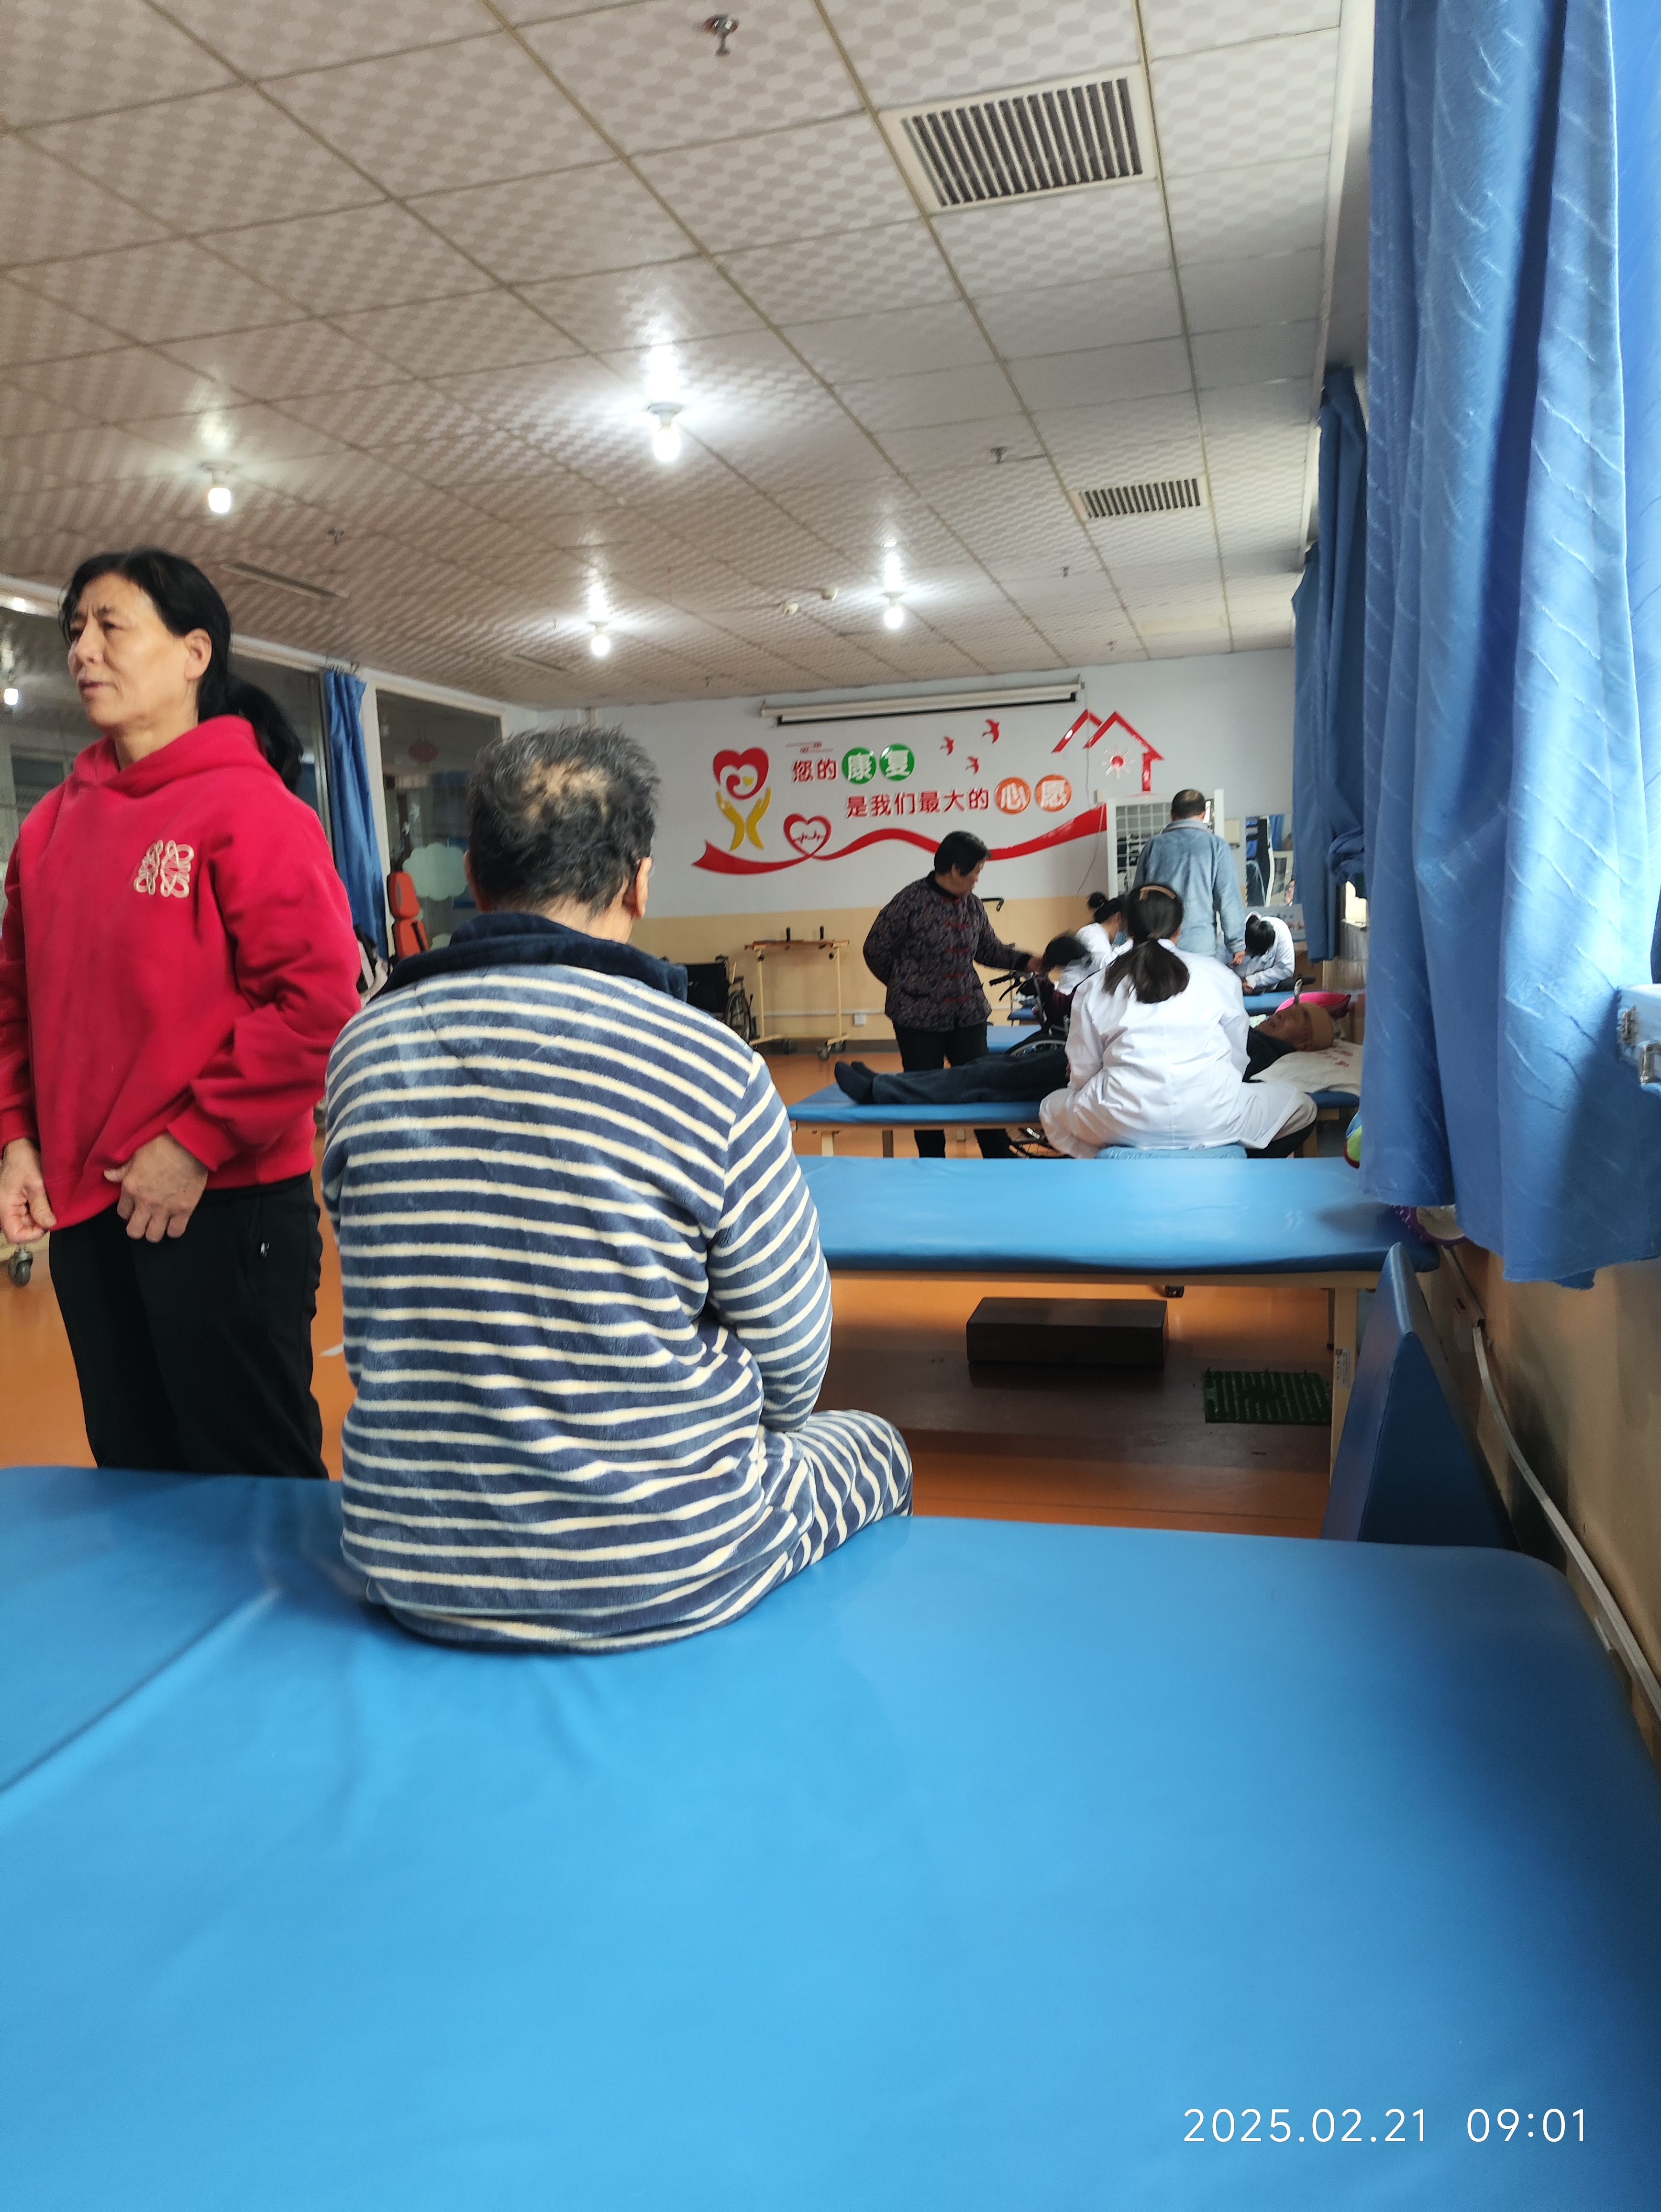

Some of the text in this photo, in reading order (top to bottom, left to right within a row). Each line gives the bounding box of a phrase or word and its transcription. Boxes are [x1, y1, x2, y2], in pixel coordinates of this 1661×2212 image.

[792, 750, 910, 783] 您的康复
[847, 780, 1067, 818] 是我们最大的心愿
